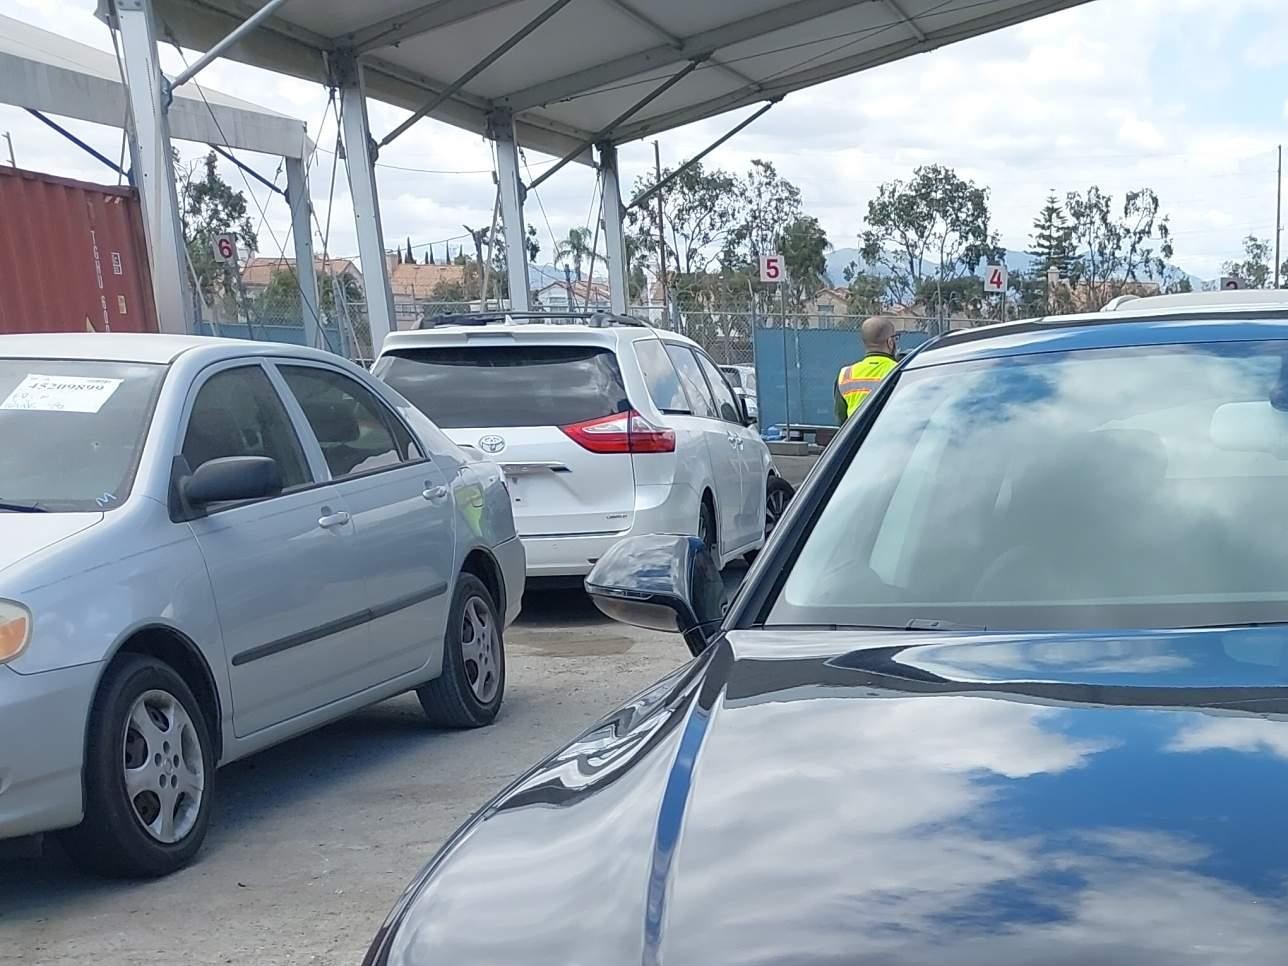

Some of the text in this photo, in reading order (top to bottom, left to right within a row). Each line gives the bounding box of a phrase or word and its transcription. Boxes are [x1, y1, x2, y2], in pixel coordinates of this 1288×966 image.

[218, 238, 233, 259] 6
[765, 258, 779, 279] 5
[989, 269, 1003, 289] 4
